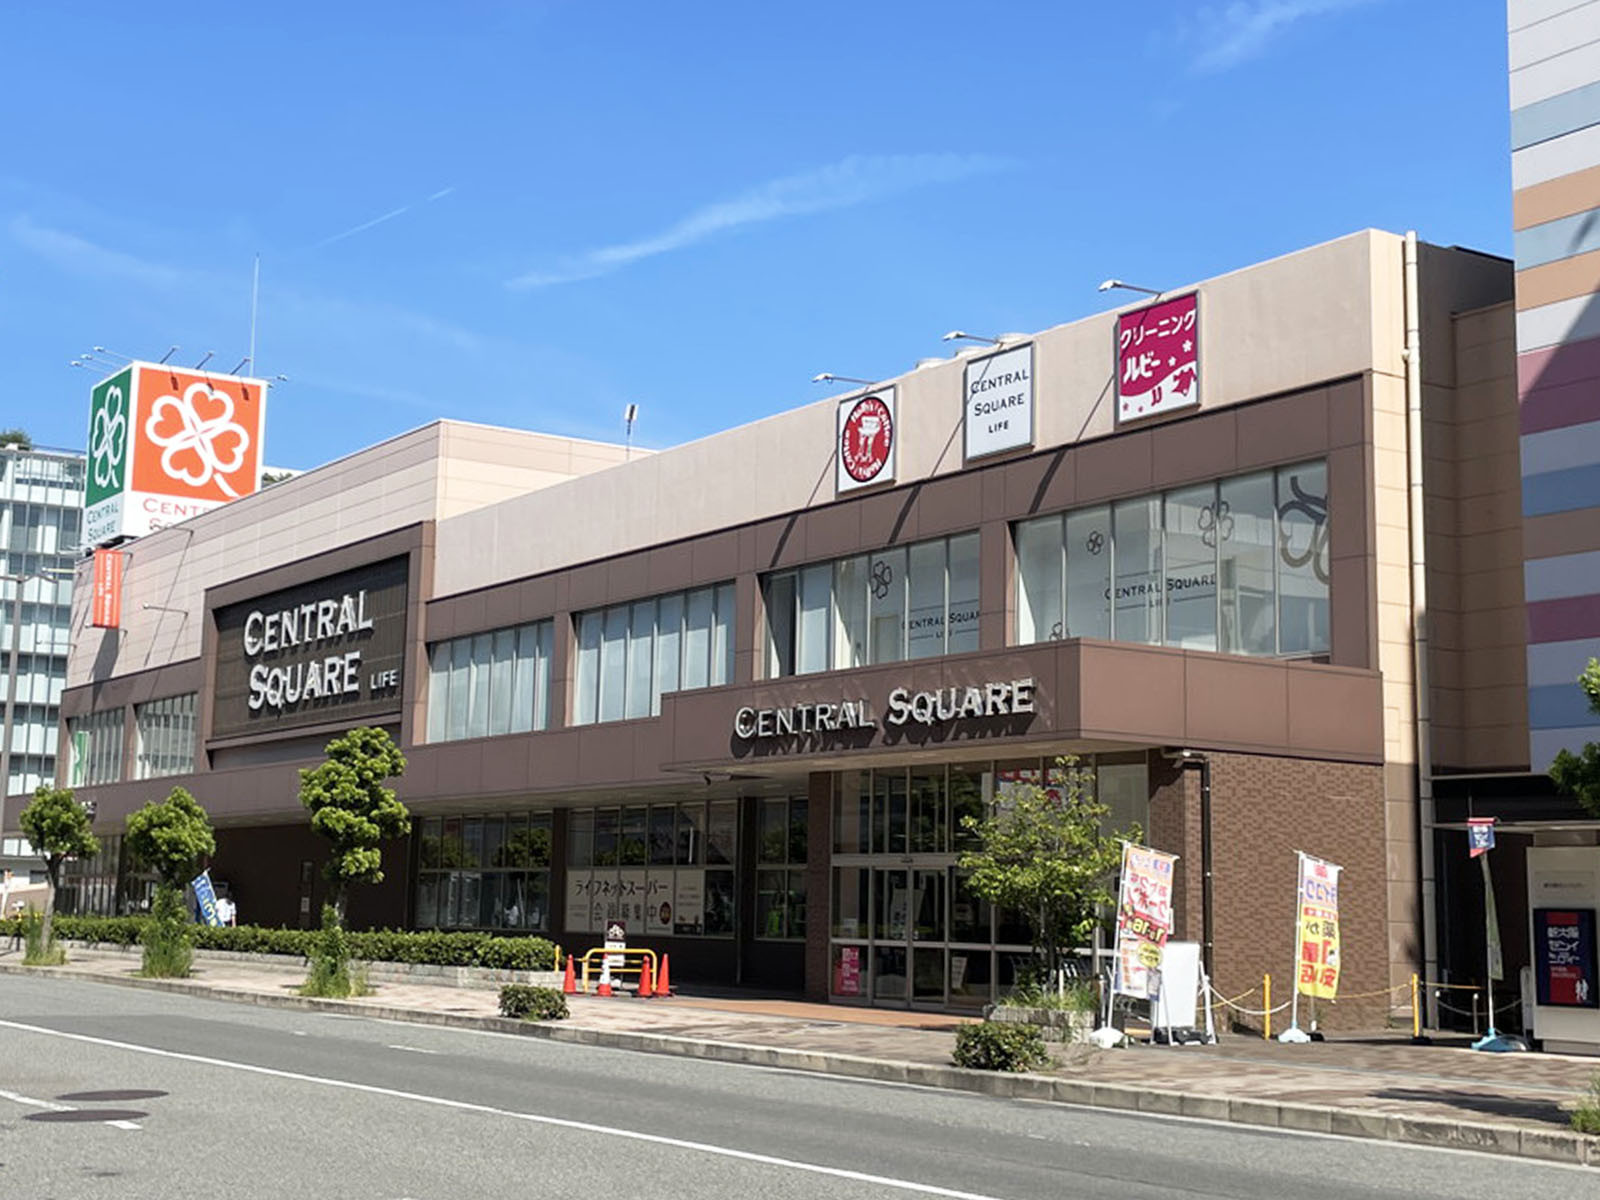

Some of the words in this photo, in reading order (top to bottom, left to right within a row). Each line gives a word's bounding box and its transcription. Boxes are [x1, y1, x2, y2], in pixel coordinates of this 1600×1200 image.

[971, 369, 1028, 394] CENTRAL
[1123, 351, 1161, 384] ルビー
[975, 393, 1024, 416] SQUARE
[988, 420, 1009, 433] LIFE
[244, 590, 373, 655] CENTRAL
[248, 651, 360, 709] SQUARE
[370, 670, 398, 689] LIFE
[735, 699, 875, 739] CENTRAL
[888, 677, 1035, 726] SQUARE
[575, 879, 669, 896] ライフネットスーパー
